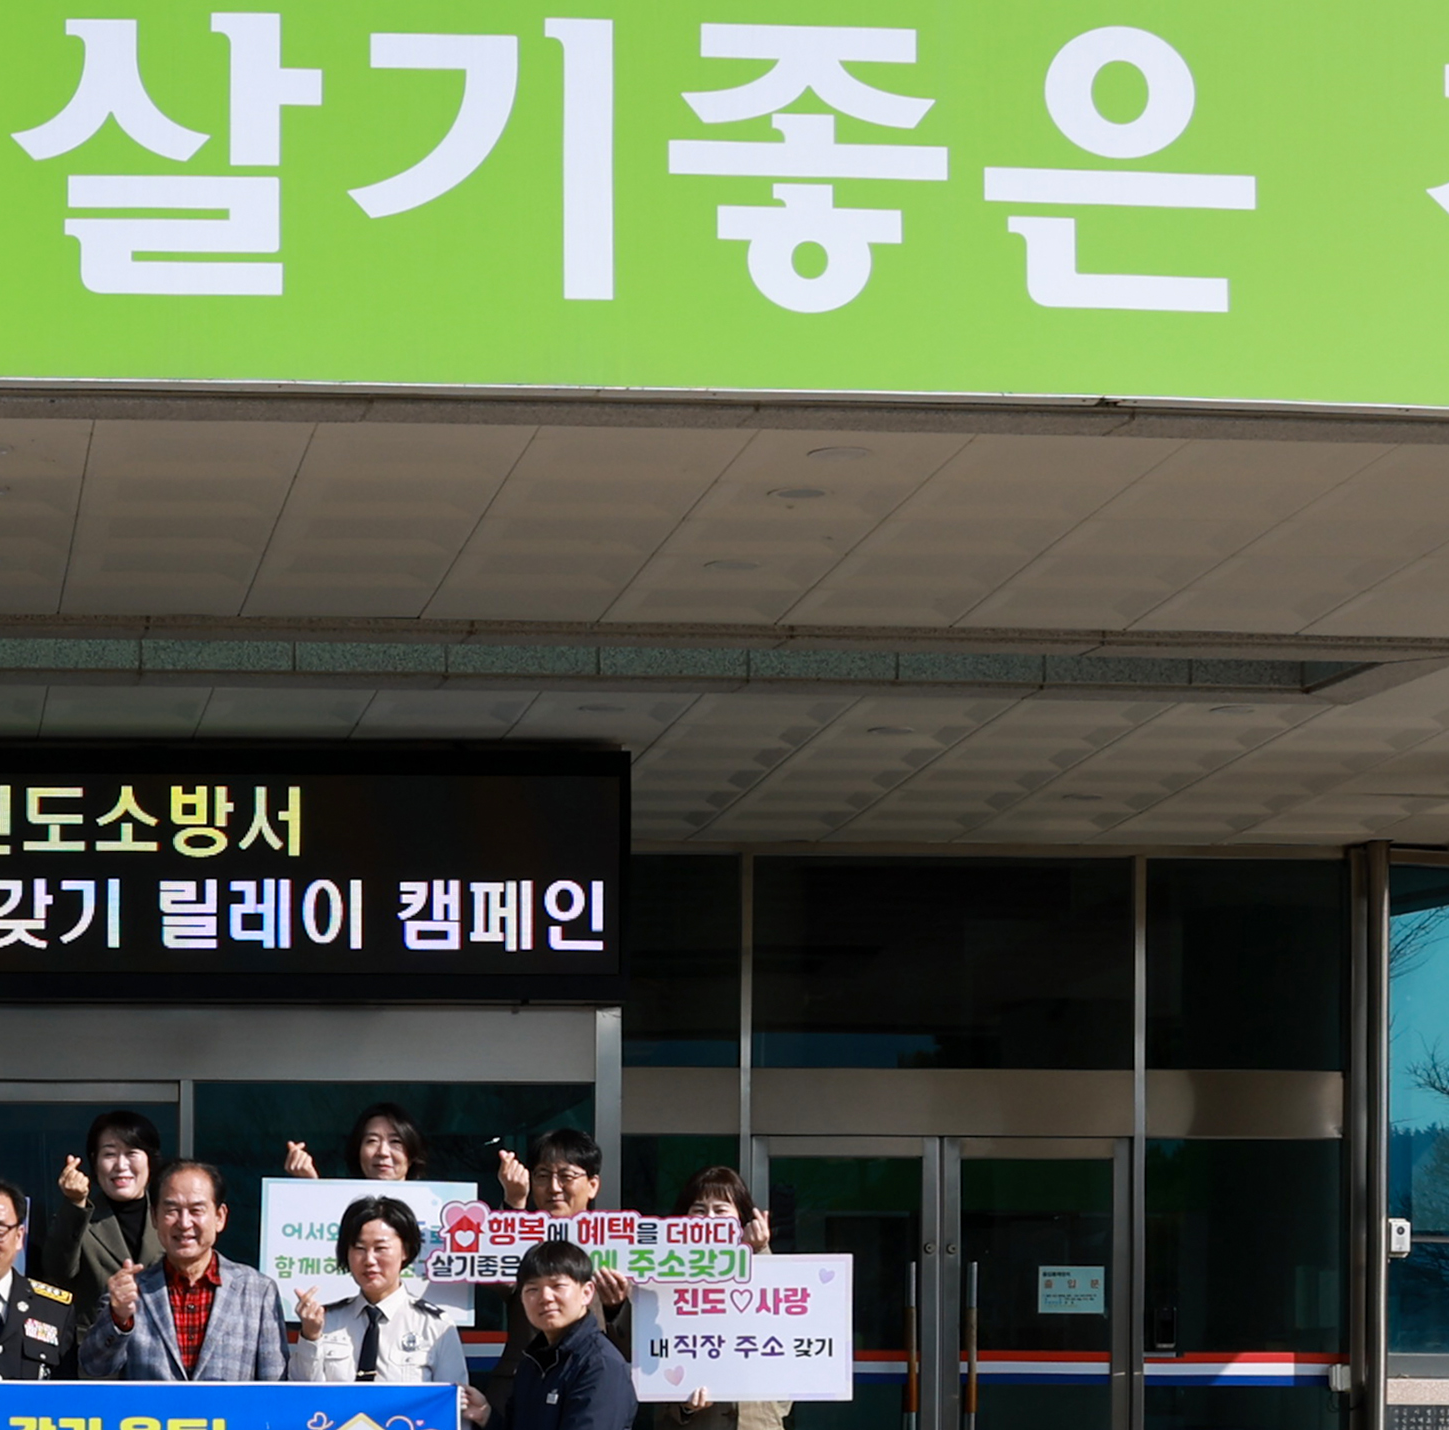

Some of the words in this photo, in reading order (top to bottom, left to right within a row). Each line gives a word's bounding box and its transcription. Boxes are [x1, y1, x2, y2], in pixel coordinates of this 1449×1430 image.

[11, 13, 1257, 315] 살기좋은
[158, 878, 364, 950] 릴레이
[397, 879, 605, 952] 캠페인
[488, 1217, 568, 1245] 행복에
[577, 1216, 658, 1245] 혜택을
[667, 1222, 735, 1245] 더하다
[431, 1255, 521, 1277] 살기좋은
[628, 1249, 746, 1278] 주소갖기
[674, 1288, 726, 1316] 진도
[756, 1287, 810, 1316] 사랑
[650, 1338, 669, 1358] 내
[674, 1335, 726, 1359] 직장
[734, 1336, 785, 1359] 주소
[794, 1338, 833, 1357] 갖기
